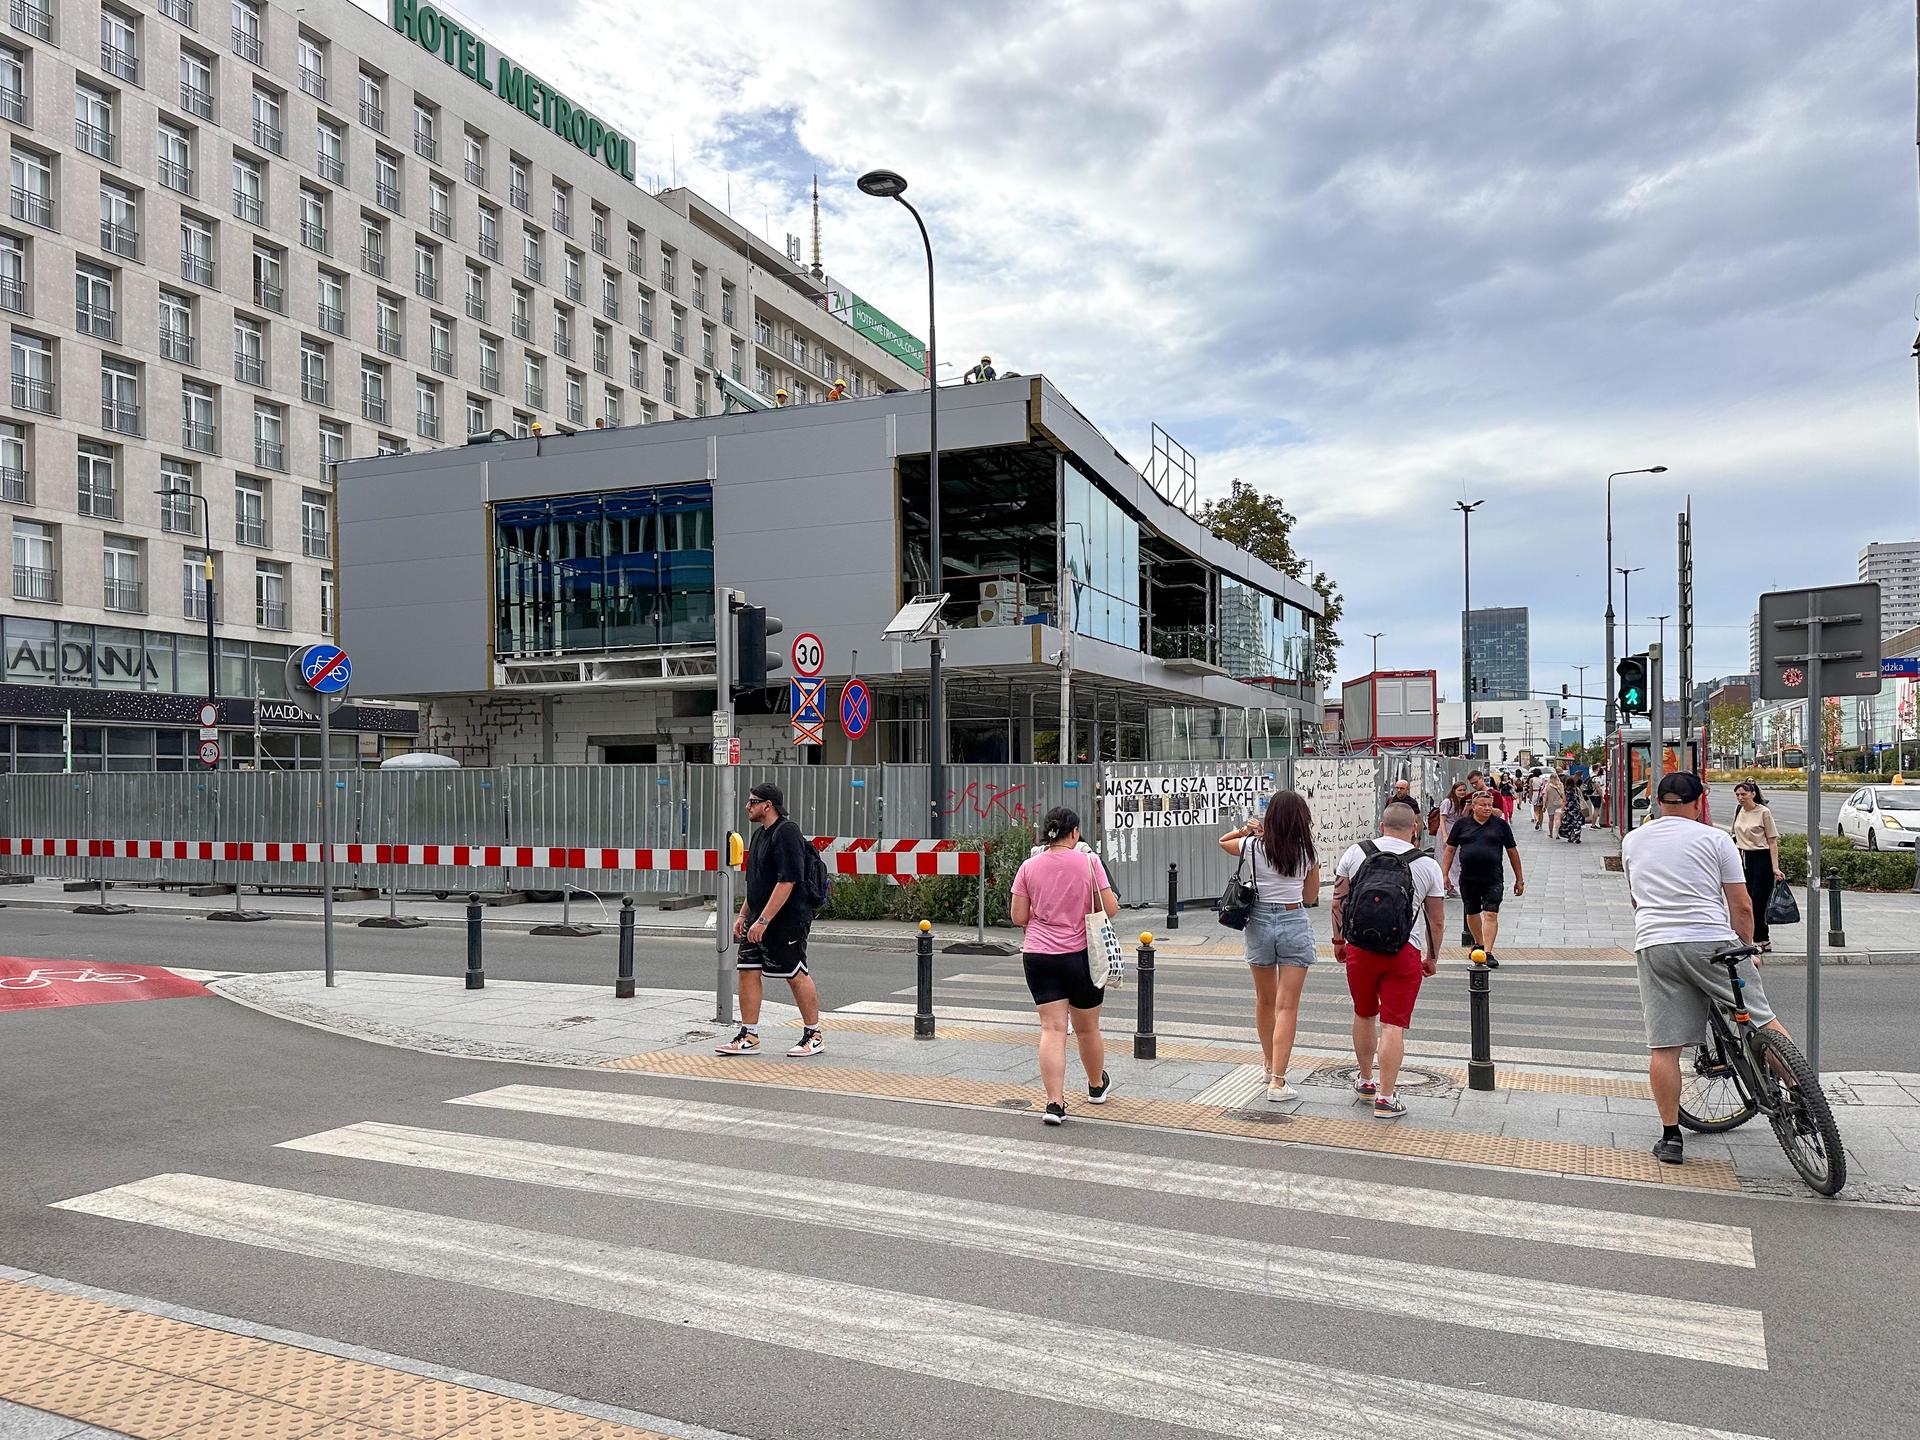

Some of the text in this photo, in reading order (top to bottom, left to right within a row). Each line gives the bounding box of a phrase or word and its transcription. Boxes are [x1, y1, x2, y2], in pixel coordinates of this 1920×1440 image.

[394, 0, 633, 181] HOTEL METROPOL
[6, 639, 159, 678] ADONNA
[797, 643, 820, 666] 30
[1105, 776, 1269, 796] WASZA CISZA BĘDZIE
[1115, 812, 1134, 828] DO
[1143, 808, 1217, 827] HISTORII
